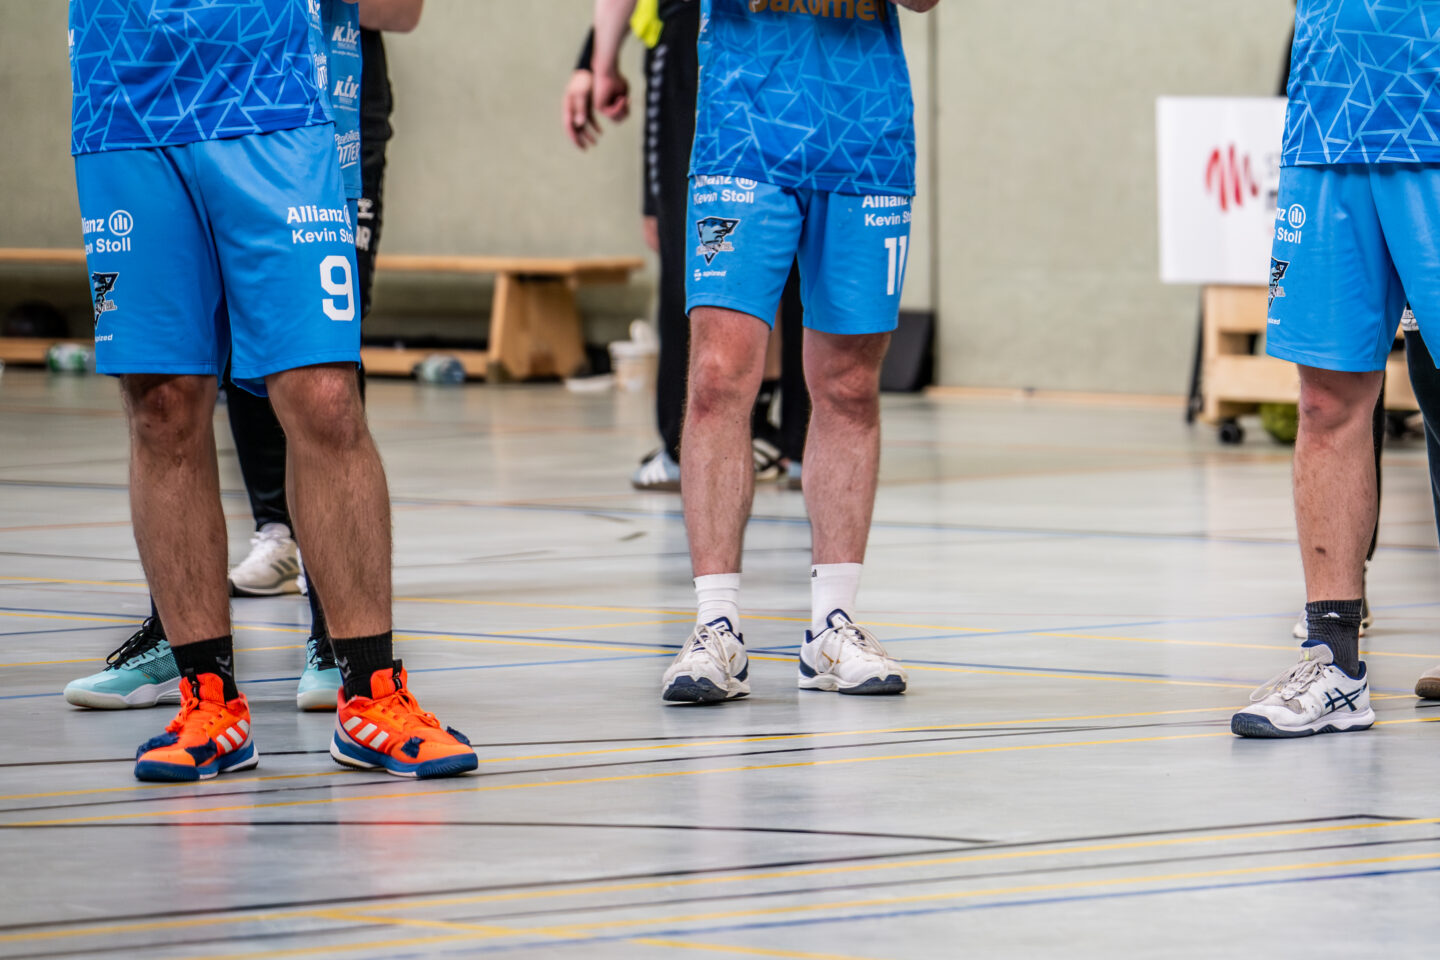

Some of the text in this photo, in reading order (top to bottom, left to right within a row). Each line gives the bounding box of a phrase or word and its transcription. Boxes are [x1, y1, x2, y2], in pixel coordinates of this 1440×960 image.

[720, 189, 754, 204] Stoll
[287, 205, 344, 224] Allianz
[865, 212, 900, 227] Kevin
[292, 228, 354, 244] Kevin Sto
[1277, 227, 1302, 244] Stoll
[96, 237, 131, 253] Stoll
[885, 235, 907, 296] 11
[320, 255, 355, 321] 9
